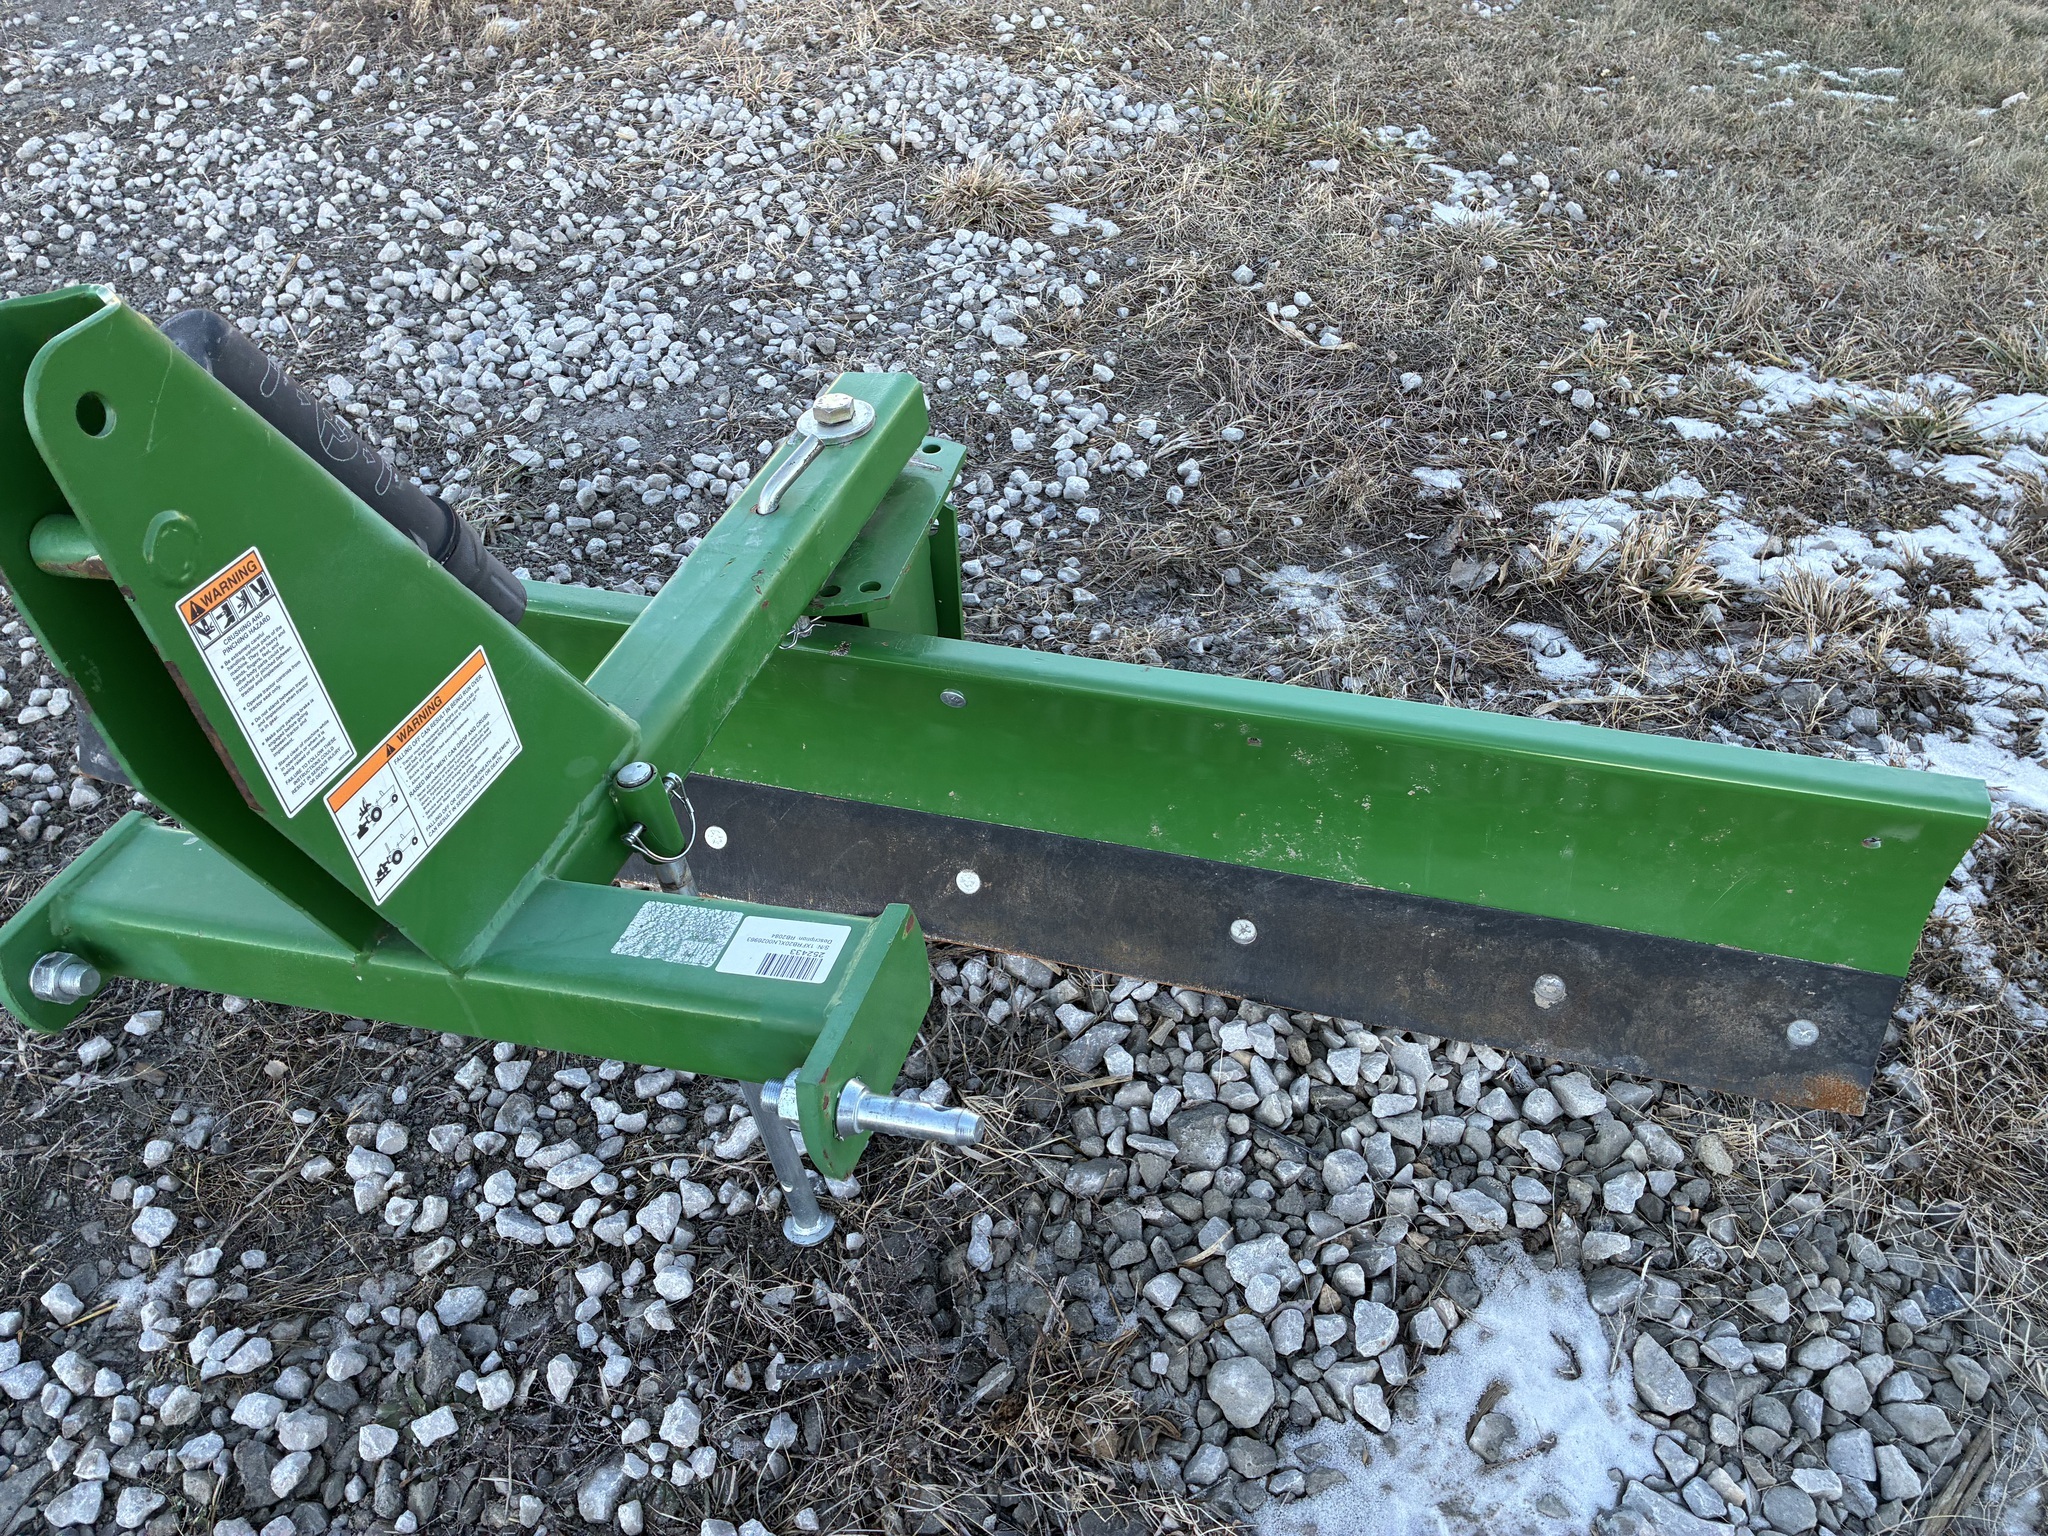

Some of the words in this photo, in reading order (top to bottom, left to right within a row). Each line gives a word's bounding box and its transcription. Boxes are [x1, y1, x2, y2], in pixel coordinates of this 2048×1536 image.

[200, 560, 257, 608] WARNING
[223, 621, 252, 646] CRUSHING
[251, 612, 264, 624] AND
[223, 632, 249, 656] PINCHING
[248, 615, 271, 635] HAZARD
[231, 643, 251, 662] extremely
[251, 632, 264, 645] careful
[227, 655, 246, 672] handling
[245, 643, 260, 657] various
[260, 634, 271, 645] parts
[233, 669, 246, 681] hands,
[247, 656, 262, 671] fingers,
[262, 649, 271, 657] feet,
[236, 676, 246, 687] other
[247, 668, 257, 678] body
[257, 659, 268, 670] parts
[268, 649, 279, 660] could
[249, 651, 259, 662] They
[266, 636, 278, 648] heavy
[238, 676, 255, 692] crushed
[260, 659, 276, 675] pinched
[276, 646, 292, 661] between
[247, 693, 263, 708] Operate
[262, 682, 276, 694] tractor
[276, 668, 291, 683] controls
[292, 660, 301, 669] from
[241, 684, 254, 697] tractor
[250, 700, 263, 712] tractor
[263, 692, 272, 701] seat
[265, 702, 286, 721] implement
[286, 693, 296, 703] when
[296, 682, 308, 694] tractor
[268, 700, 280, 711] stand
[279, 686, 295, 702] between
[295, 676, 308, 688] tractor
[266, 732, 276, 742] Make
[276, 725, 285, 733] sure
[285, 711, 300, 726] parking
[299, 702, 310, 713] brake
[268, 731, 285, 748] engaged
[285, 720, 297, 733] before
[297, 711, 308, 722] going
[271, 737, 287, 752] between
[287, 726, 299, 738] tractor
[394, 745, 412, 765] FALLING
[412, 736, 421, 747] OFF
[421, 727, 430, 738] CAN
[430, 711, 446, 729] RESULT
[450, 694, 463, 709] BEING
[462, 685, 471, 696] RUN
[471, 674, 483, 688] OVER.
[398, 696, 442, 744] WARNING
[278, 755, 290, 766] Stand
[290, 747, 299, 756] clear
[304, 728, 319, 743] machine
[319, 720, 329, 729] while
[285, 750, 303, 768] operation
[308, 737, 318, 747] when
[286, 768, 302, 785] FAILURE
[308, 748, 324, 765] FOLLOW
[324, 737, 336, 750] THESE
[409, 779, 425, 797] RAISED
[424, 755, 448, 781] IMPLEMENT
[448, 746, 457, 757] CAN
[456, 734, 468, 748] DROP
[468, 726, 476, 736] AND
[476, 711, 490, 728] CRUSH.
[283, 765, 294, 777] being
[294, 754, 306, 766] raised
[292, 780, 306, 795] RESULT
[311, 760, 328, 777] SERIOUS
[328, 747, 341, 761] INJURY
[294, 759, 321, 785] INSTRUCTIONS
[321, 746, 334, 760] COULD
[426, 813, 442, 832] FALLING
[450, 798, 456, 806] OR
[456, 784, 468, 799] GOING
[468, 759, 492, 786] UNDERNEATH
[492, 738, 511, 761] IMPLEMENT
[428, 826, 438, 838] CAN
[437, 811, 452, 828] RESULT
[456, 788, 472, 807] SERIOUS
[472, 775, 485, 790] INJURY
[485, 768, 491, 776] OR
[789, 949, 825, 958] 252433
